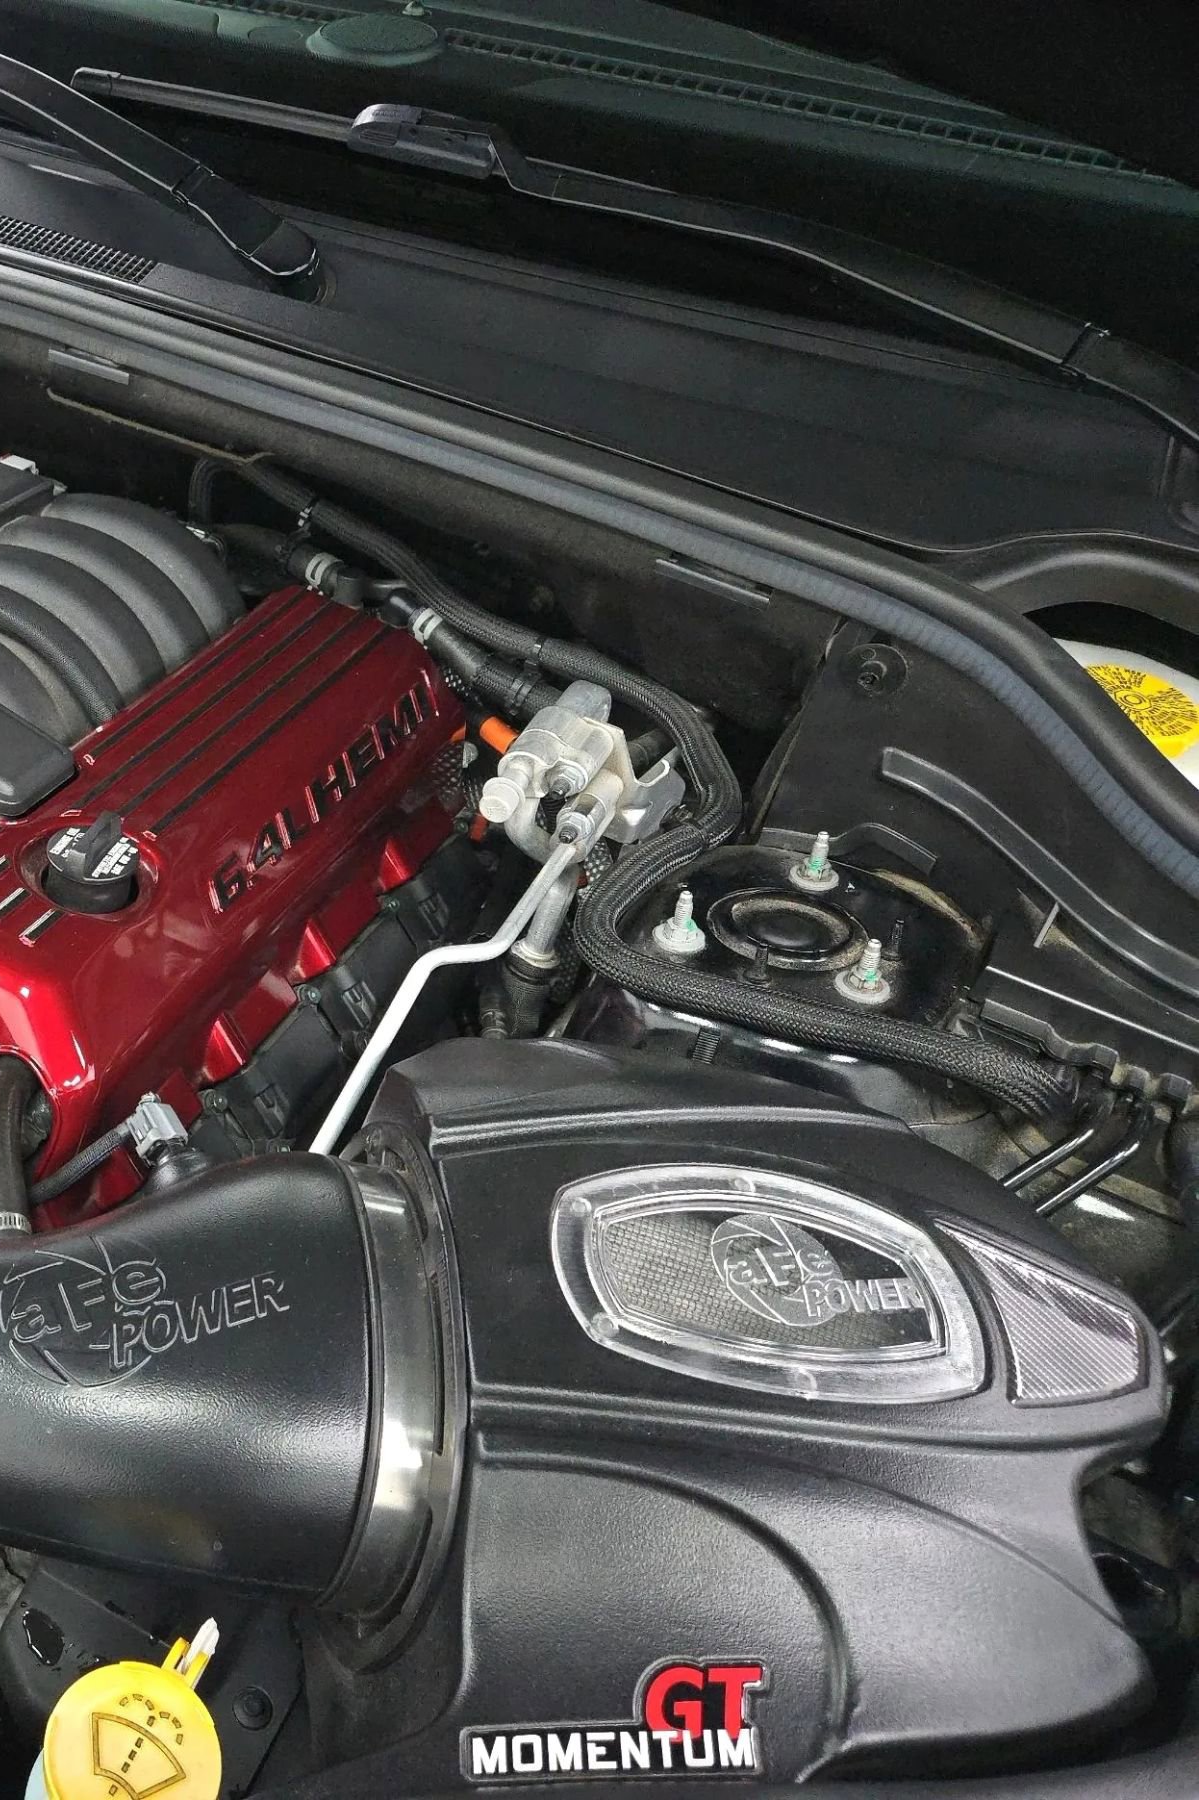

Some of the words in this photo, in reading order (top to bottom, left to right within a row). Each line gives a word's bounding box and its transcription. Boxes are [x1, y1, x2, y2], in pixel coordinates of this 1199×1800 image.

[304, 668, 440, 824] HEMI
[10, 1260, 166, 1343] aFe
[723, 1247, 834, 1286] aFe
[803, 1277, 927, 1317] POWER
[109, 1271, 290, 1372] POWER
[645, 1666, 762, 1744] GT
[472, 1728, 759, 1775] MOMENTUM
